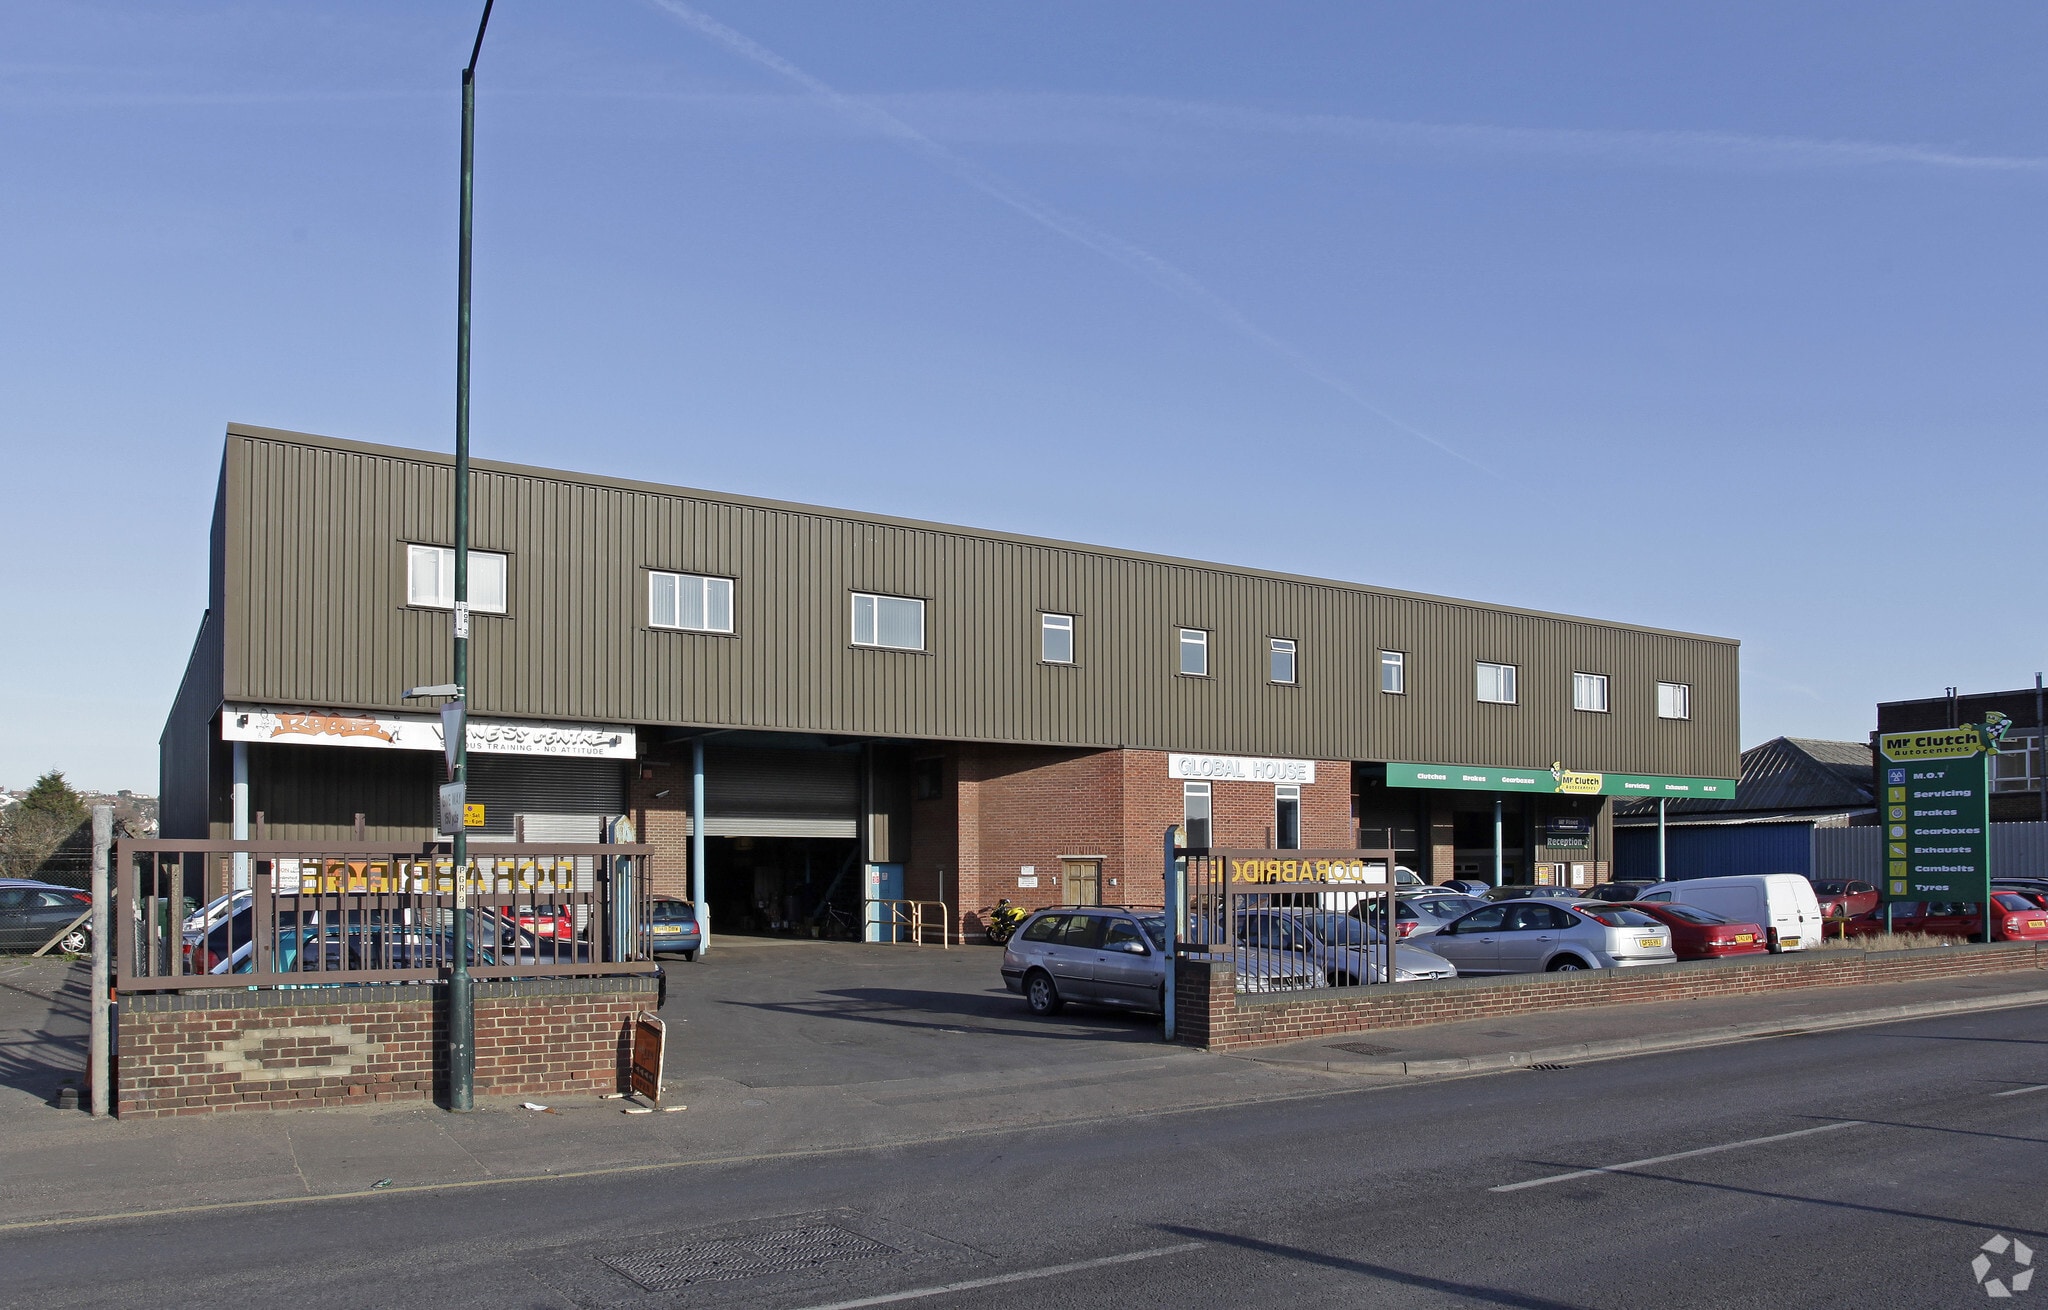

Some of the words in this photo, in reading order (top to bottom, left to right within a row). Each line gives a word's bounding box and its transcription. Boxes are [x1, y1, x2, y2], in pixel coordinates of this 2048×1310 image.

[1887, 738, 1911, 749] Mr
[1915, 733, 1978, 748] Clutch
[487, 743, 532, 752] TRAINING
[561, 747, 604, 755] ATTITUDE
[1894, 746, 1969, 756] Autocentres
[1178, 756, 1246, 778] GLOBAL
[1252, 760, 1307, 781] HOUSE
[1417, 773, 1447, 781] Clutches
[1501, 776, 1535, 785] Gearboxes
[1913, 772, 1945, 780] M.O.T
[1575, 777, 1599, 786] Clutch
[1624, 782, 1650, 790] Servicing
[1914, 789, 1972, 799] Servicing
[1914, 809, 1958, 817] Brakes
[1914, 827, 1981, 836] Gearboxes
[1547, 837, 1583, 847] Reception
[1914, 846, 1972, 854] Exhausts
[1914, 865, 1975, 873] Cambelts
[1914, 884, 1950, 892] Tyres
